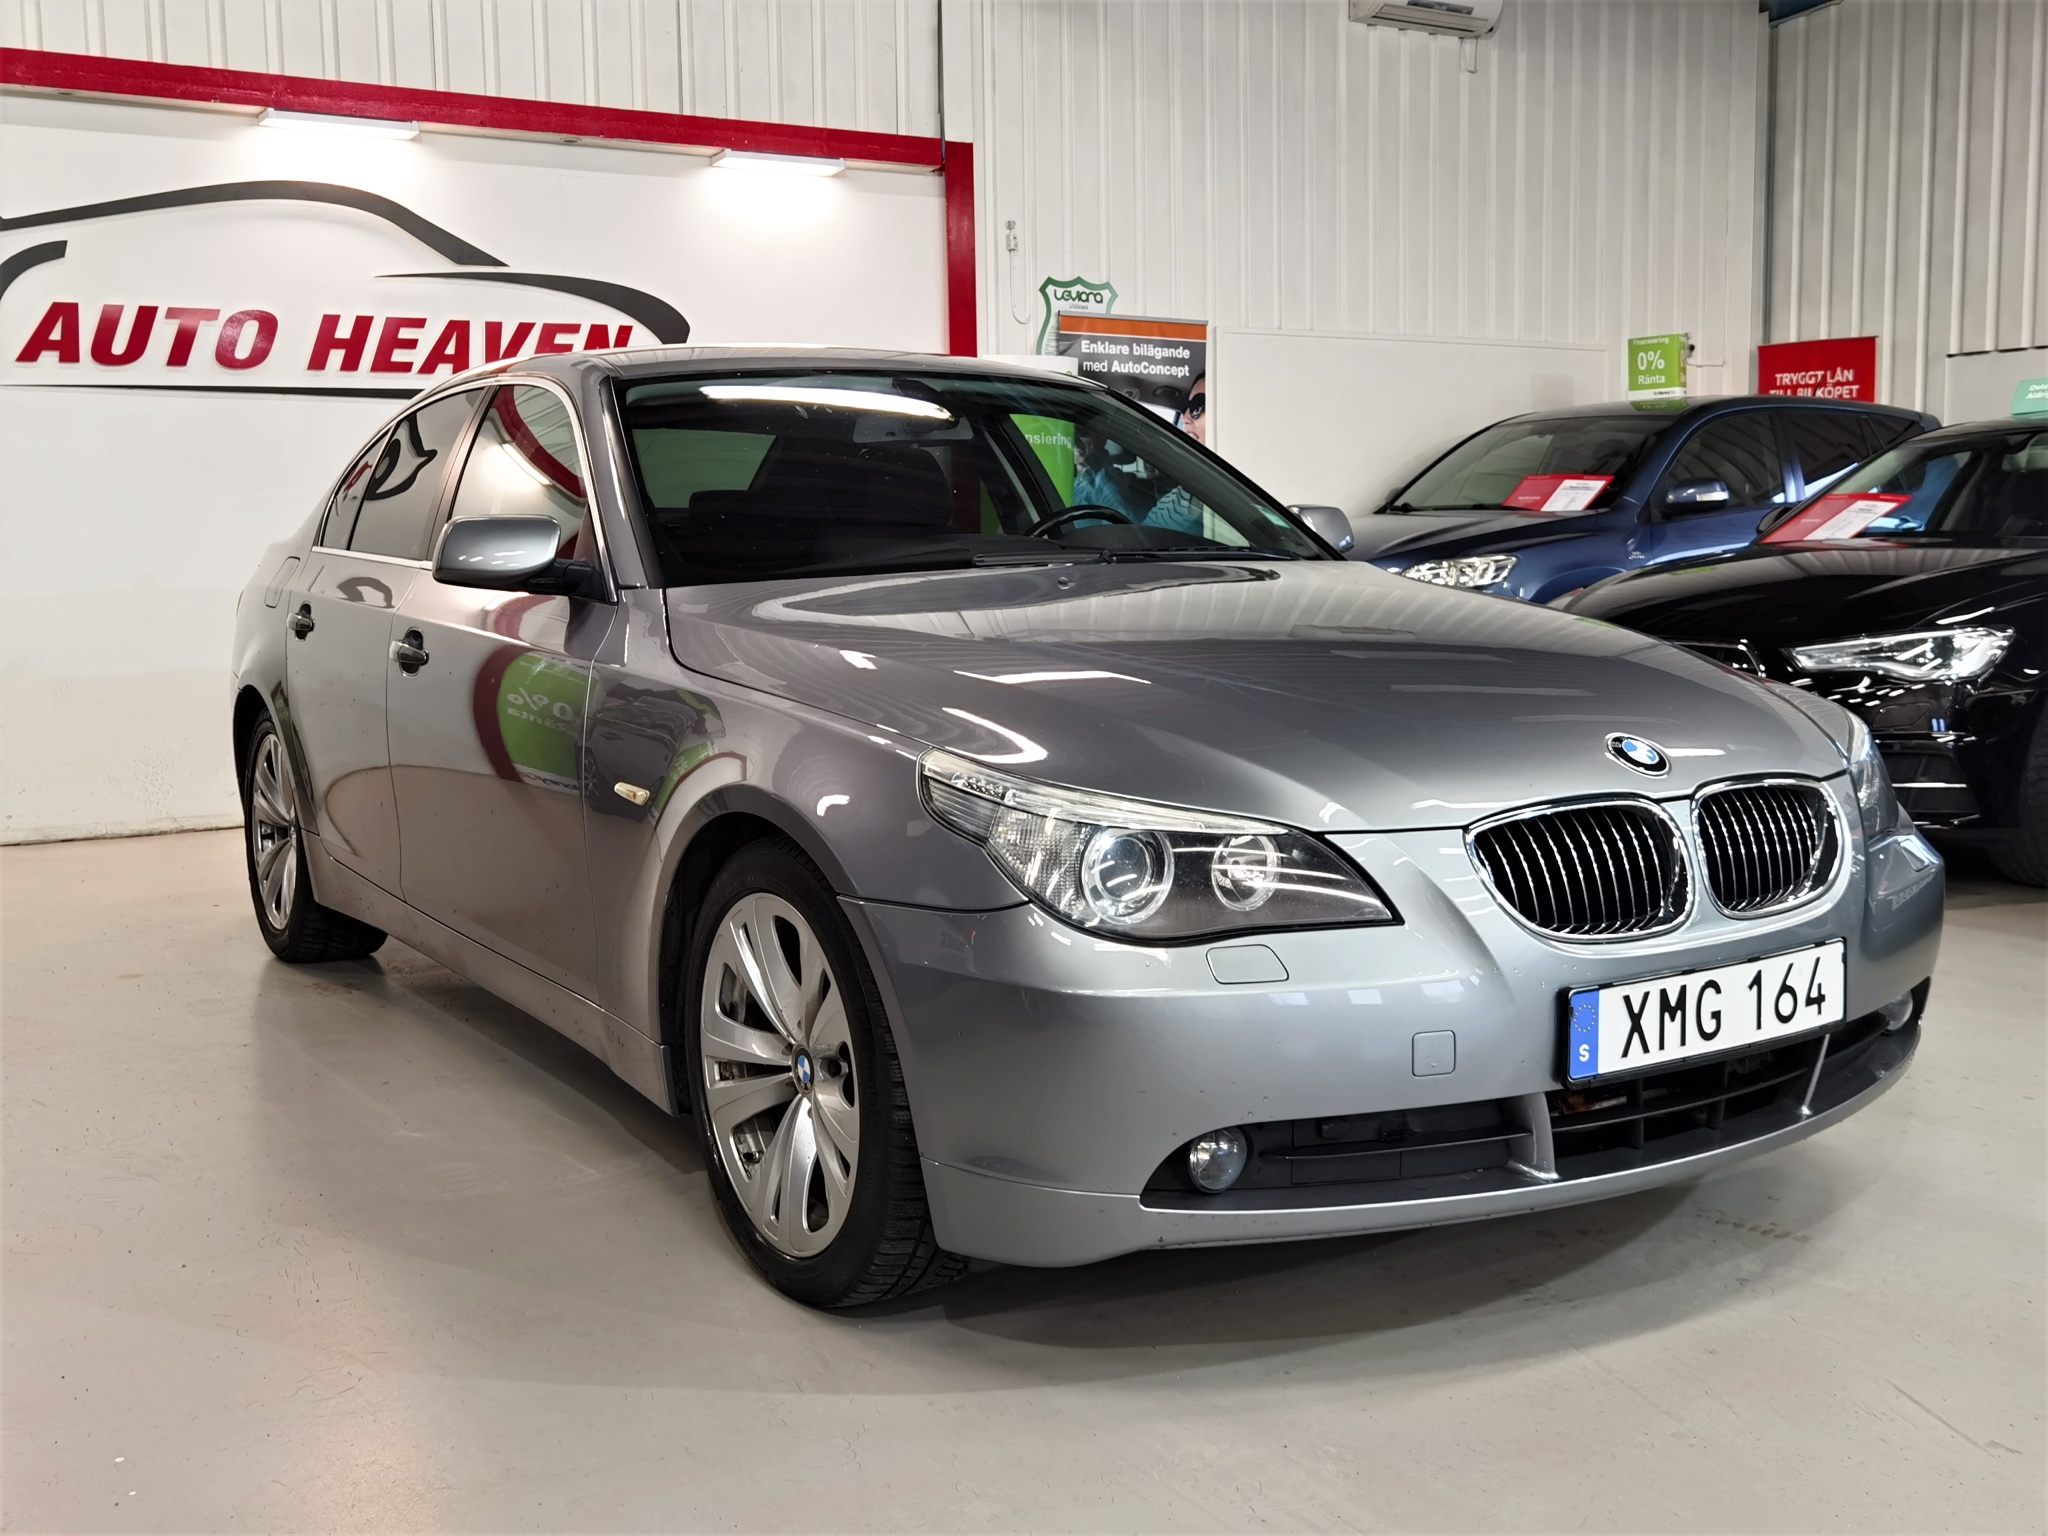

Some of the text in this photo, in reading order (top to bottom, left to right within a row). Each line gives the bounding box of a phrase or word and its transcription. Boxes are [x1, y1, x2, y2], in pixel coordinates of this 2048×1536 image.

[15, 301, 279, 370] AUTO
[1632, 336, 1670, 346] Finansiering
[1081, 340, 1190, 359] Enklare bilägande
[1082, 360, 1190, 378] med AutoConcept
[1637, 350, 1665, 370] 0%
[1637, 373, 1667, 385] Ränta
[1774, 366, 1855, 386] TRYGGT LÅN
[1620, 956, 1826, 1059] XMG 164
[1578, 1043, 1590, 1063] S
